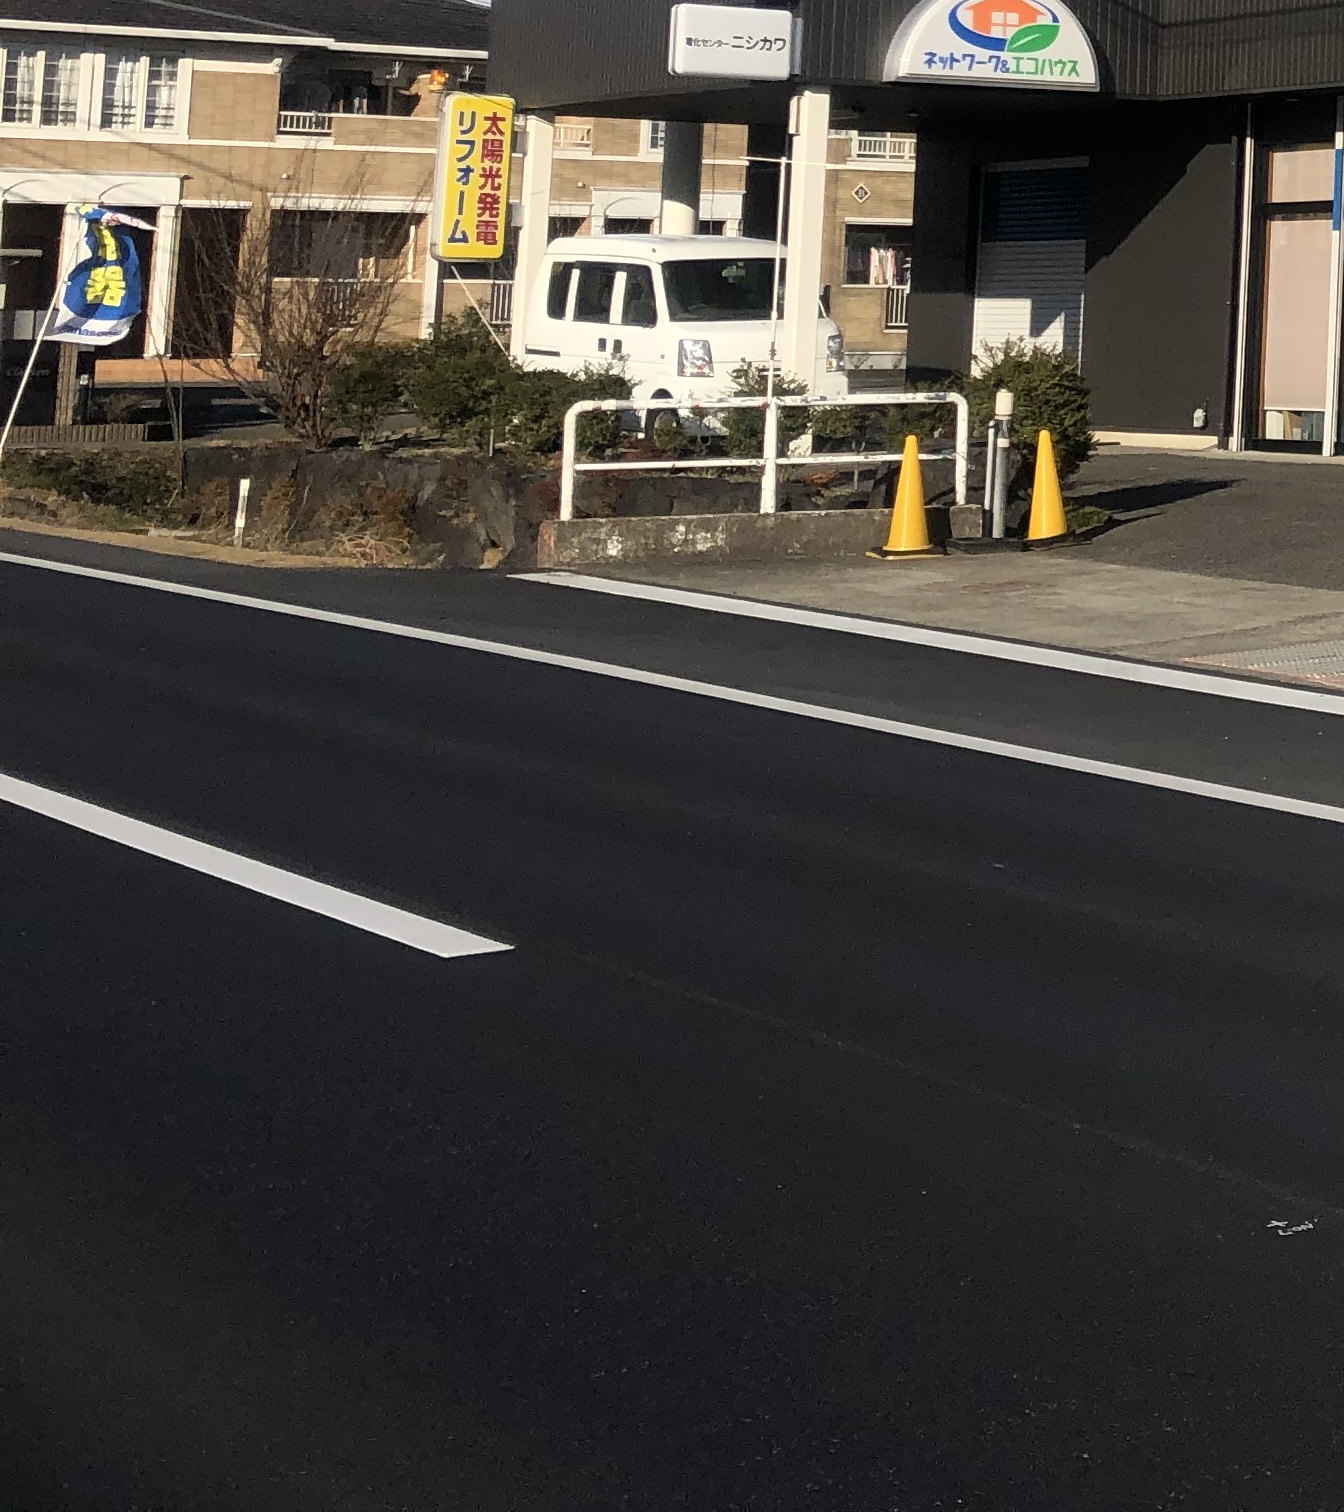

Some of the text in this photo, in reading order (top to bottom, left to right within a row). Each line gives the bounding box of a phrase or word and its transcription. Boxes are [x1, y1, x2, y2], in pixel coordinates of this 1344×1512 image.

[447, 110, 477, 244] リフォーム
[475, 111, 507, 246] 太陽光発電
